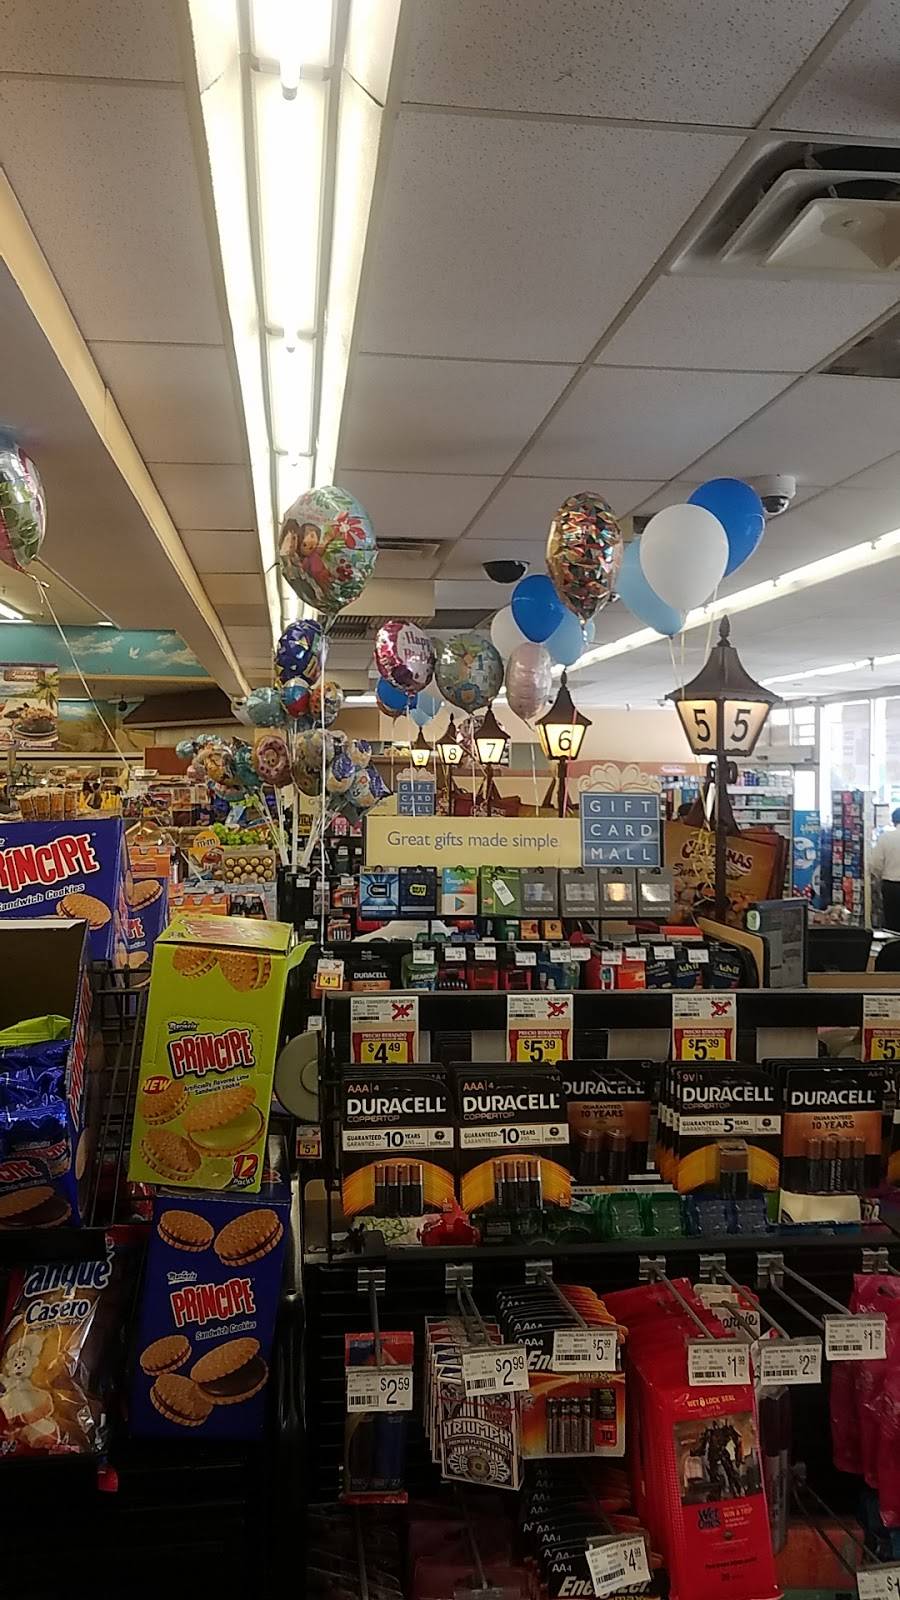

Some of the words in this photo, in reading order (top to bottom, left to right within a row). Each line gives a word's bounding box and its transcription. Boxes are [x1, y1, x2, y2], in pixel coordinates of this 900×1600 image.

[694, 708, 710, 742] 5
[733, 708, 752, 742] 5
[558, 729, 572, 751] 6
[448, 747, 457, 761] 8
[485, 742, 496, 759] 7
[589, 800, 651, 813] GIFT
[590, 823, 653, 837] CARD
[387, 831, 430, 846] Great
[434, 832, 463, 850] gifts
[468, 833, 507, 847] made
[591, 847, 651, 861] MALL
[0, 893, 44, 911] andwich
[45, 883, 86, 900] Cookies
[142, 1079, 171, 1091] NEW
[561, 1080, 645, 1095] DURACELL
[463, 1093, 560, 1113] DURACELL
[682, 1086, 774, 1103] DURACELL
[791, 1089, 876, 1106] DURACELL
[346, 1097, 446, 1115] DURACELL
[580, 1110, 591, 1118] 10
[593, 1110, 624, 1118] YEARS
[346, 1115, 400, 1123] COPPERTOP
[463, 1111, 515, 1120] COPPERTOP
[723, 1118, 734, 1133] 5
[812, 1121, 822, 1130] 10
[825, 1120, 855, 1129] YEARS
[384, 1131, 404, 1148] 10
[500, 1128, 520, 1144] 10
[232, 1154, 259, 1178] 12
[25, 1299, 91, 1324] Casero
[195, 1326, 228, 1340] Sandwich
[446, 1420, 512, 1449] TRIUMPH
